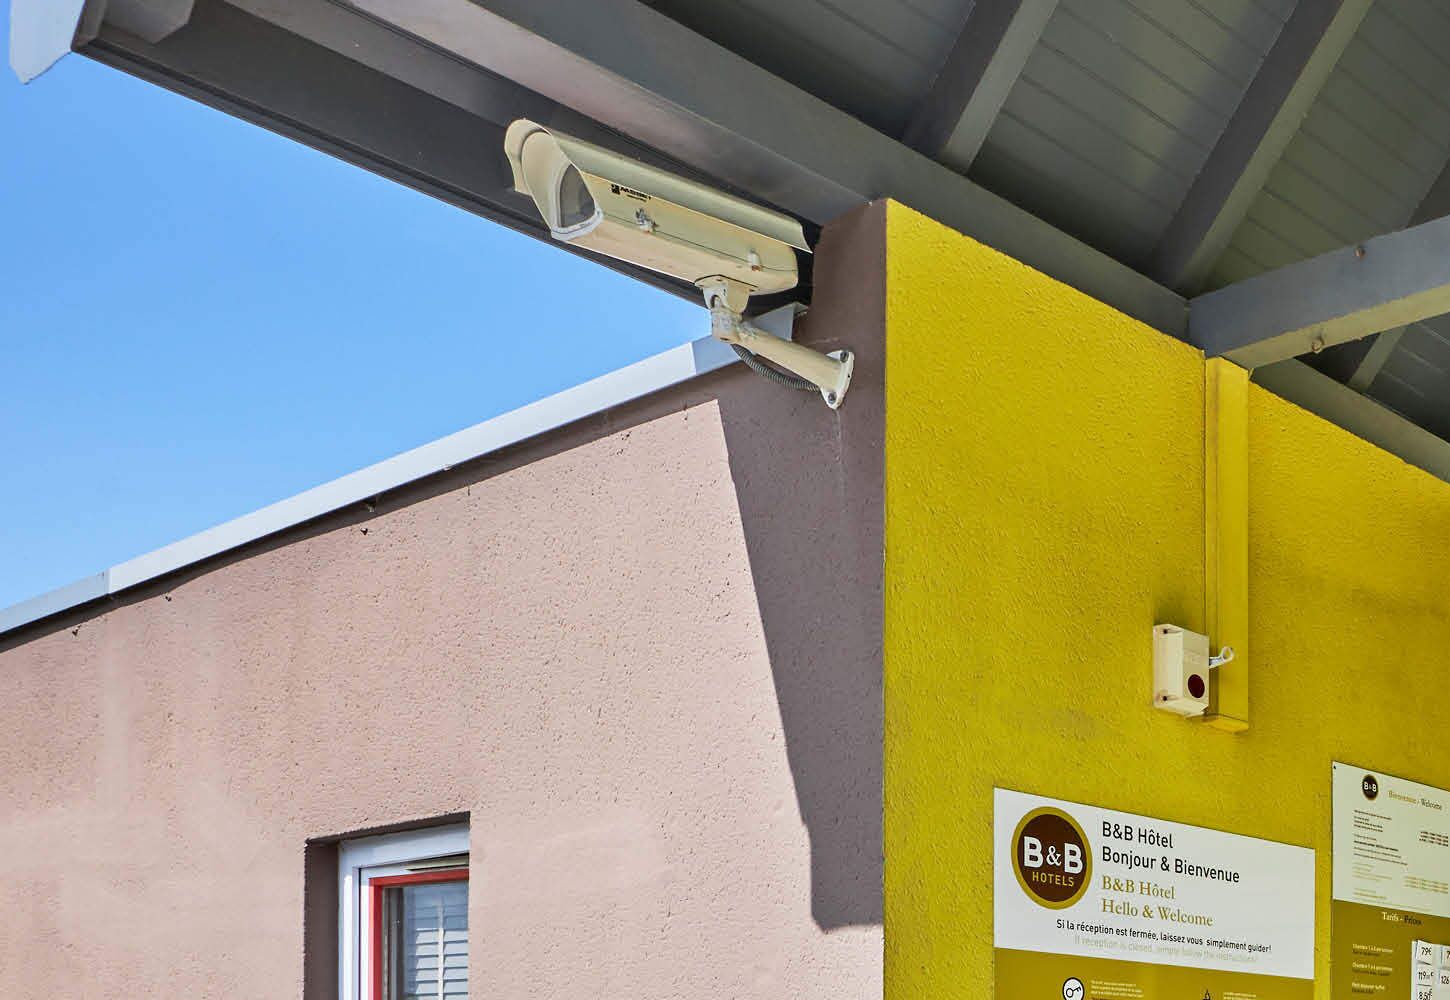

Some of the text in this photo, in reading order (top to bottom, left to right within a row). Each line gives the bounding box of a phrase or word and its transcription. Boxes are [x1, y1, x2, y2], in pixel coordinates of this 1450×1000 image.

[1102, 821, 1174, 849] B&B Hôtel
[1023, 836, 1084, 875] B&B
[1102, 846, 1240, 883] Bonjour & Bienvenue
[1032, 870, 1075, 887] HOTELS
[1101, 875, 1175, 900] B&B Hôtel
[1101, 898, 1214, 927] Hello & Welcome
[1381, 911, 1399, 922] Tarifs
[1056, 919, 1065, 929] Si
[1066, 920, 1074, 930] la
[1076, 921, 1114, 937] réception
[1115, 927, 1128, 937] est
[1129, 928, 1159, 941] fermée,
[1160, 932, 1185, 944] laissez
[1186, 936, 1203, 946] vous
[1206, 938, 1247, 952] simplement
[1247, 943, 1272, 954] guider!
